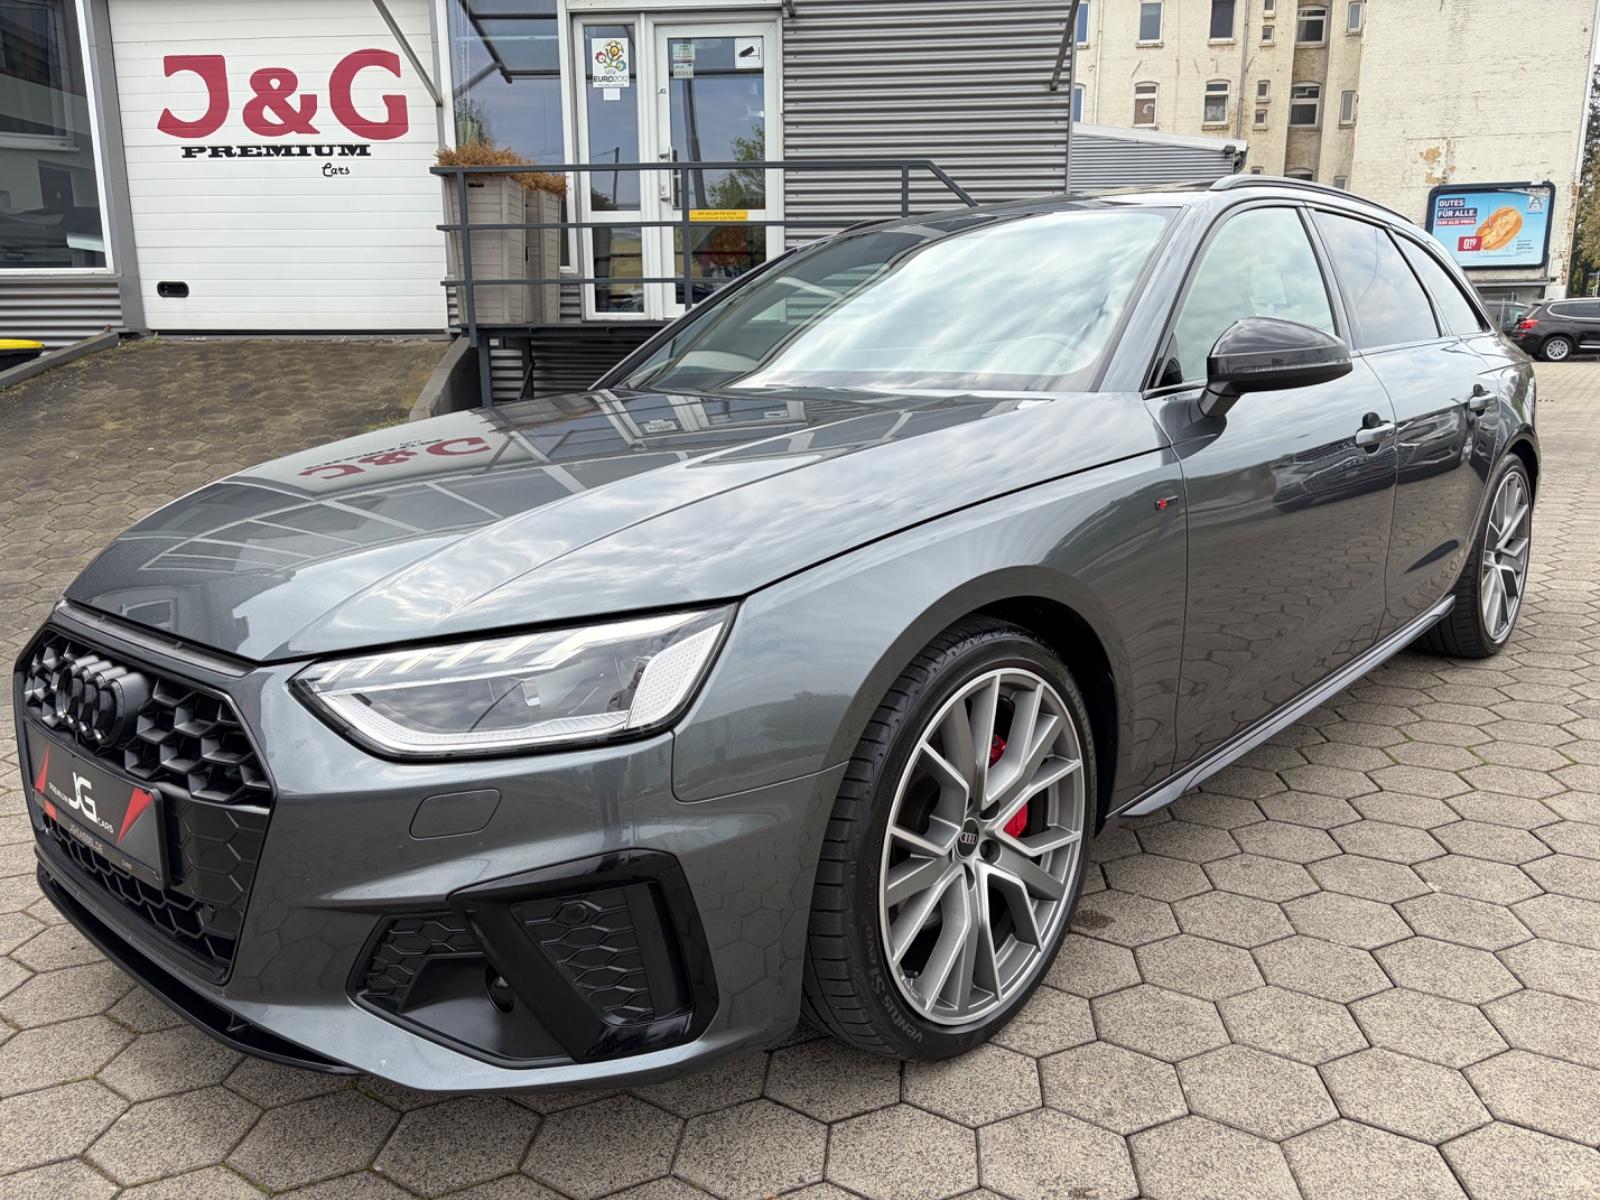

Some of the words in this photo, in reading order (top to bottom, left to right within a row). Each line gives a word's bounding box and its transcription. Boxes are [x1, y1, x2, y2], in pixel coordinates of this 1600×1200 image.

[157, 48, 409, 140] J&G
[181, 144, 371, 158] PREMIUM
[321, 162, 350, 178] Cars
[1439, 199, 1464, 207] GUTES
[1438, 208, 1454, 218] FÜR
